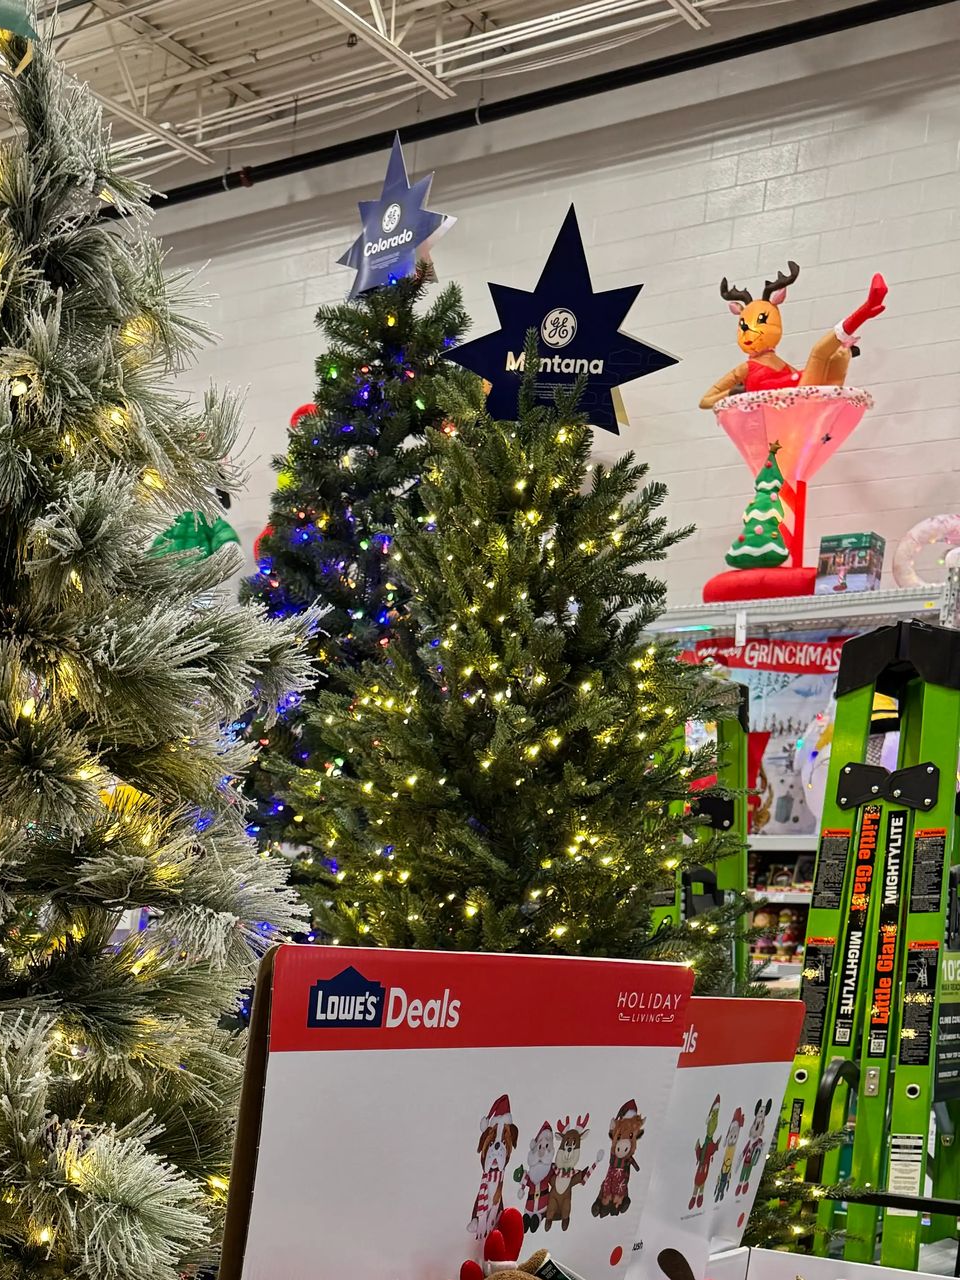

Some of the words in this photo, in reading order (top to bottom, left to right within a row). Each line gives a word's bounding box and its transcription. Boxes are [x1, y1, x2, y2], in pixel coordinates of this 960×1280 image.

[363, 228, 413, 257] Colorado
[505, 351, 604, 375] Mntana
[743, 641, 842, 672] GRINCHMAS
[858, 812, 880, 860] Little
[884, 817, 904, 905] MIGHTYLITE
[839, 931, 863, 1015] MIGHTYLITE
[315, 990, 377, 1021] LOWE'S
[385, 986, 462, 1029] Deals
[616, 991, 682, 1010] HOLIDAY
[871, 977, 892, 1024] Little
[631, 1012, 661, 1023] LIVING
[632, 1240, 644, 1252] ush
